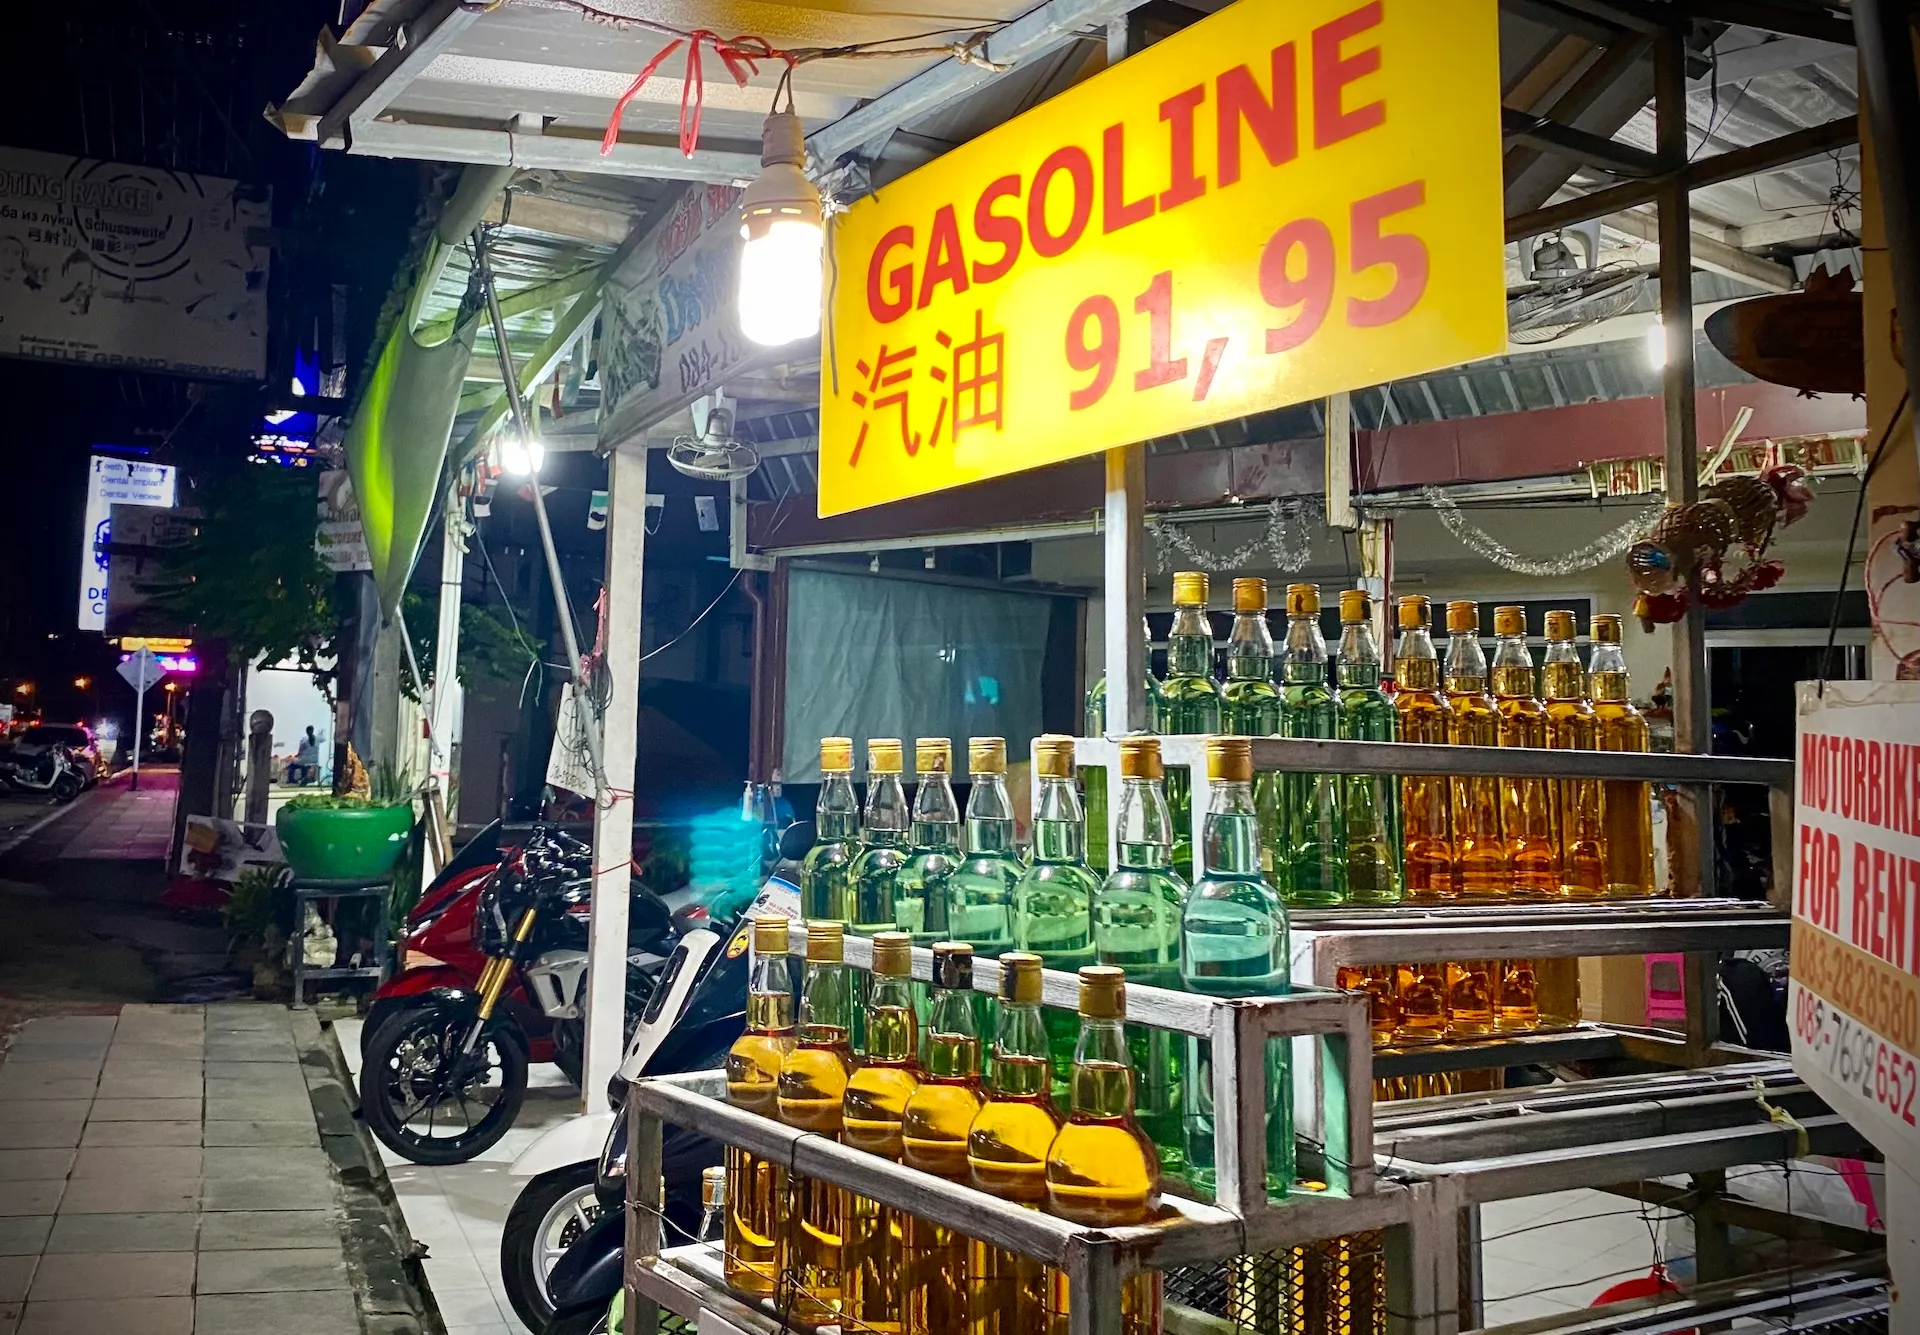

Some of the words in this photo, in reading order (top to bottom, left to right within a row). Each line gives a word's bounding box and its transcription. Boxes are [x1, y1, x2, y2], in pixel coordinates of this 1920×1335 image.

[866, 1, 1387, 323] GASOLINE
[22, 211, 38, 222] из
[41, 213, 73, 227] лука
[72, 179, 153, 217] RANGE
[84, 217, 167, 239] Schussweite
[1258, 180, 1430, 355] 95
[19, 343, 88, 362] LITTLE
[93, 353, 168, 370] GRAND
[849, 309, 1004, 468] 汽油
[100, 489, 128, 499] Dental
[101, 475, 129, 485] Dental
[1802, 733, 1920, 837] MOTORBIKE
[1798, 824, 1841, 934] FOR
[1853, 841, 1920, 978] RENT
[1798, 927, 1918, 1050] 083-2828580
